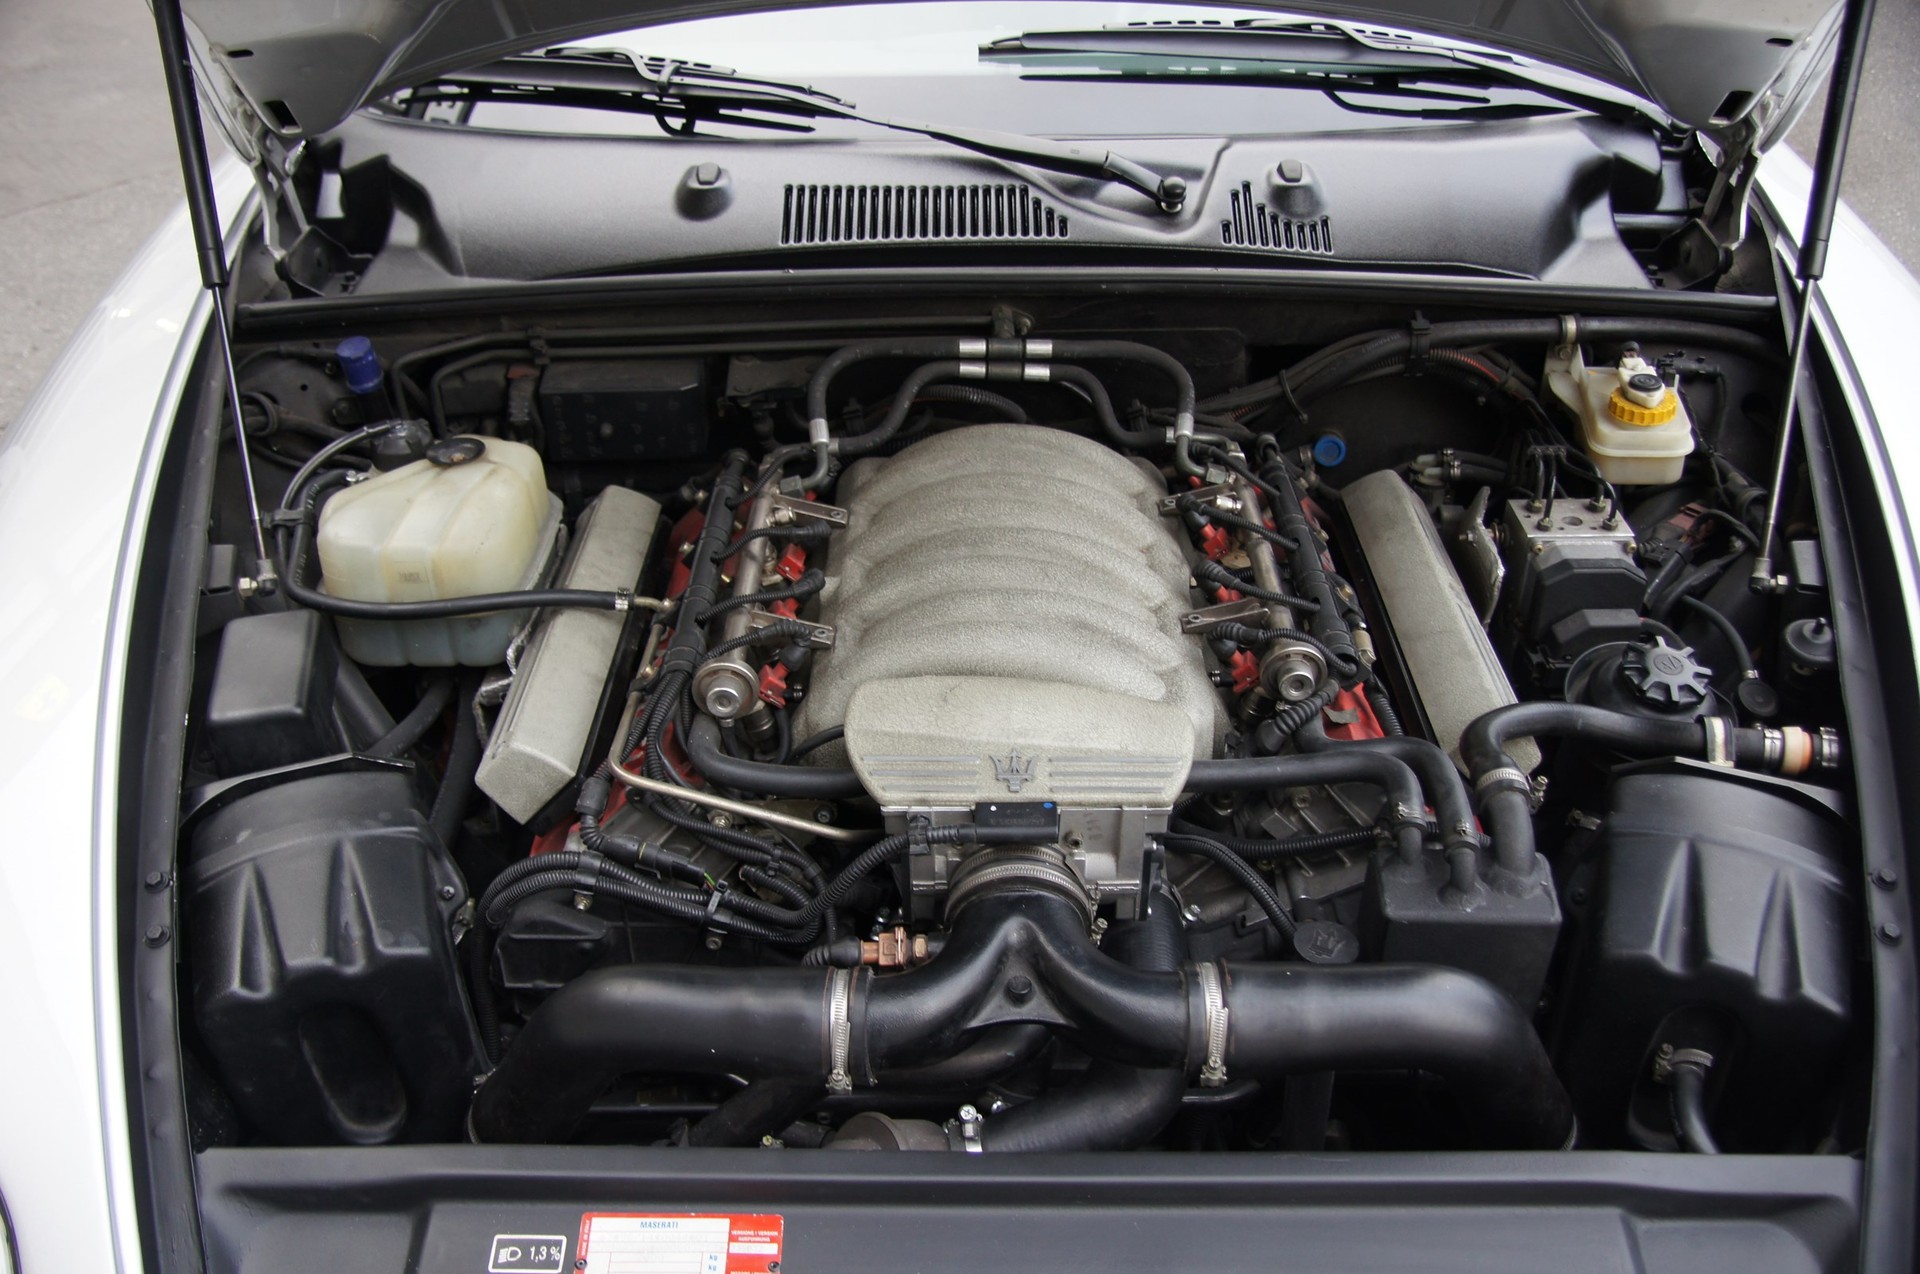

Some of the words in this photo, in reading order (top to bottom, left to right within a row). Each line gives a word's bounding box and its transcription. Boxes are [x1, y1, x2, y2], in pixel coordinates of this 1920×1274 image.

[640, 1221, 679, 1229] MASERATI
[530, 1245, 547, 1262] 1,3
[550, 1246, 561, 1261] %
